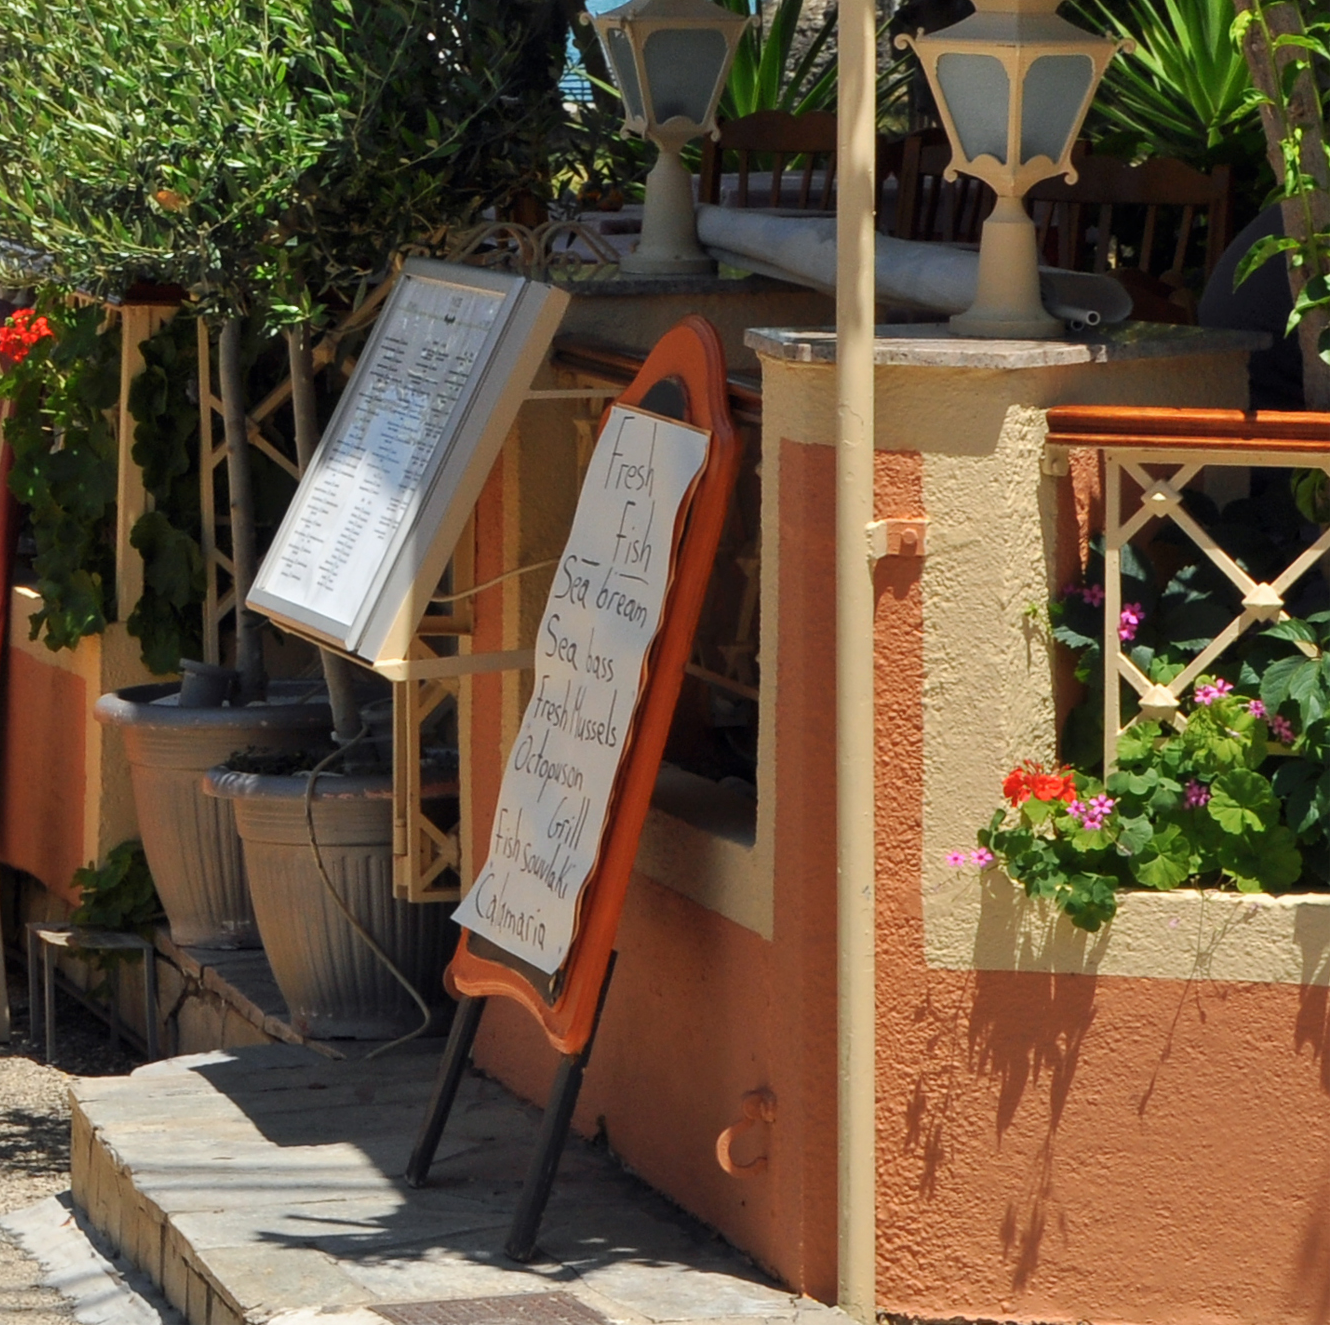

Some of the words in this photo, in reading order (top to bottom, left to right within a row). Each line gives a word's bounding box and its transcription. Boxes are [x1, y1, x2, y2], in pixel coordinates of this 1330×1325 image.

[554, 555, 590, 609] Sea
[596, 567, 648, 629] bream
[545, 613, 578, 671] Sea
[585, 627, 614, 682] bass
[547, 796, 591, 851] Grill
